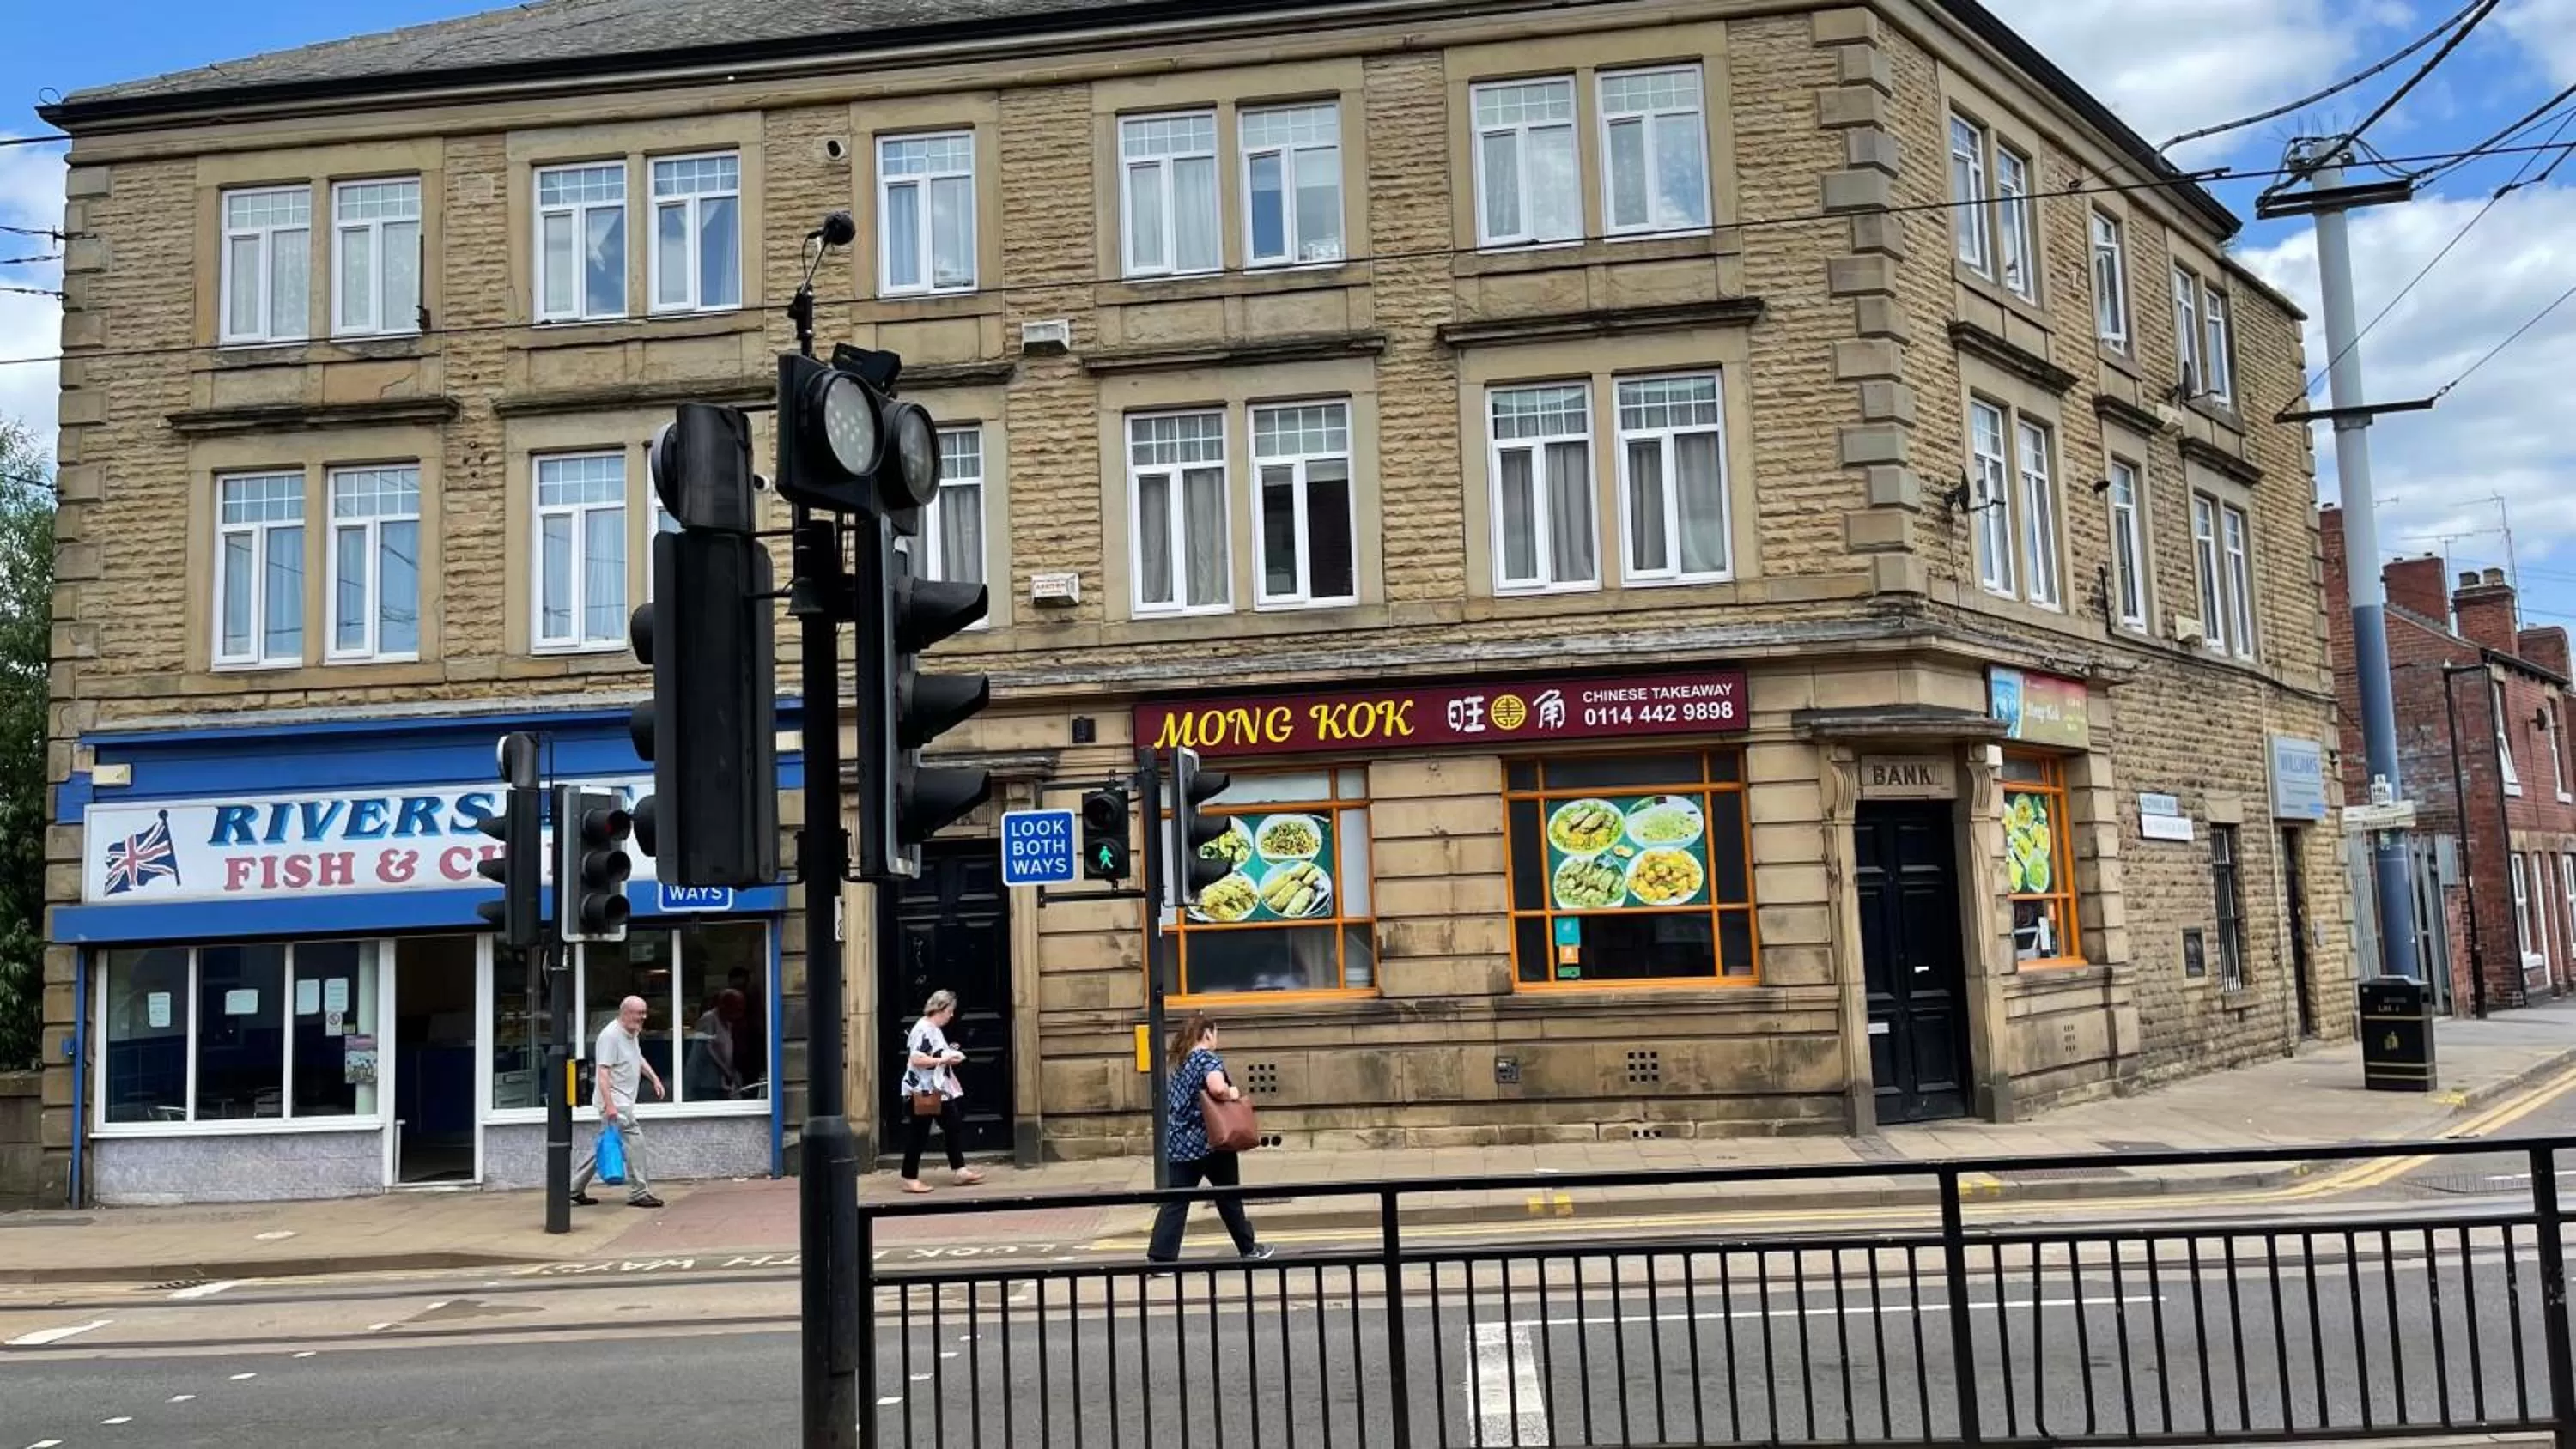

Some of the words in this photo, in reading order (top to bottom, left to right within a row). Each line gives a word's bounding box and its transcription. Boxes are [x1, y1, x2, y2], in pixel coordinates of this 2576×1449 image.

[1583, 688, 1648, 704] CHINESE
[1651, 683, 1733, 699] TAKEAWAY
[1446, 695, 1486, 733] 旺
[1532, 689, 1566, 731] 角
[1583, 706, 1633, 726] 0114
[1639, 704, 1677, 724] 442
[1683, 701, 1734, 721] 9898
[1153, 706, 1294, 749] MONG
[1309, 700, 1415, 740] KOK
[1872, 764, 1933, 785] BANK
[1011, 820, 1065, 836] LOOK
[1012, 840, 1065, 856] BOTH
[223, 851, 356, 891] FISH
[375, 848, 419, 883] &
[1012, 858, 1067, 875] WAYS
[669, 885, 723, 901] WAYS
